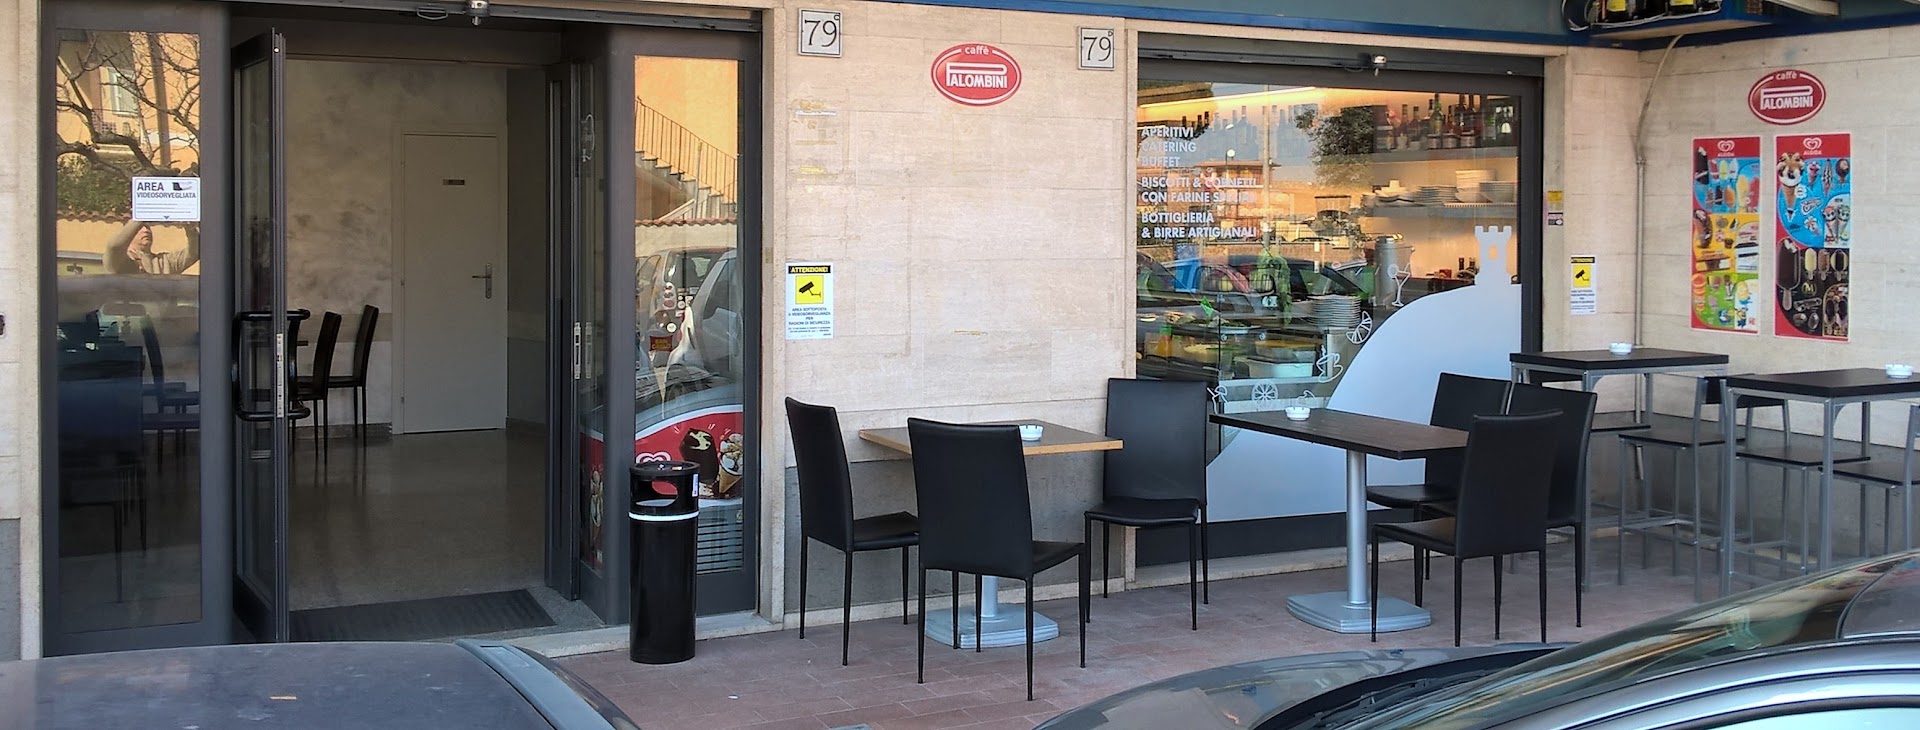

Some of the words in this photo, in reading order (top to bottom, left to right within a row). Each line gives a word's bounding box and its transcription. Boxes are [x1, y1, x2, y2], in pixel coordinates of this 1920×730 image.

[804, 19, 837, 47] 79
[964, 45, 989, 55] caffè
[1083, 36, 1111, 61] 79
[946, 62, 1008, 88] PALOMBINI
[1775, 71, 1797, 80] caffè
[1760, 85, 1813, 110] PALOMBINI
[1141, 127, 1194, 138] APERITIVI
[1141, 141, 1197, 152] CATERING
[1141, 156, 1180, 167] BUFFET
[137, 182, 164, 191] AREA
[1141, 177, 1190, 188] BISCOTTI
[1193, 177, 1201, 188] &
[1141, 191, 1167, 203] CON
[1171, 192, 1210, 202] FARINE
[1141, 212, 1215, 223] BOTTIGLIERIA
[1141, 227, 1151, 238] &
[1154, 226, 1185, 238] BIRRE
[1188, 226, 1257, 238] ARTIGIANALI
